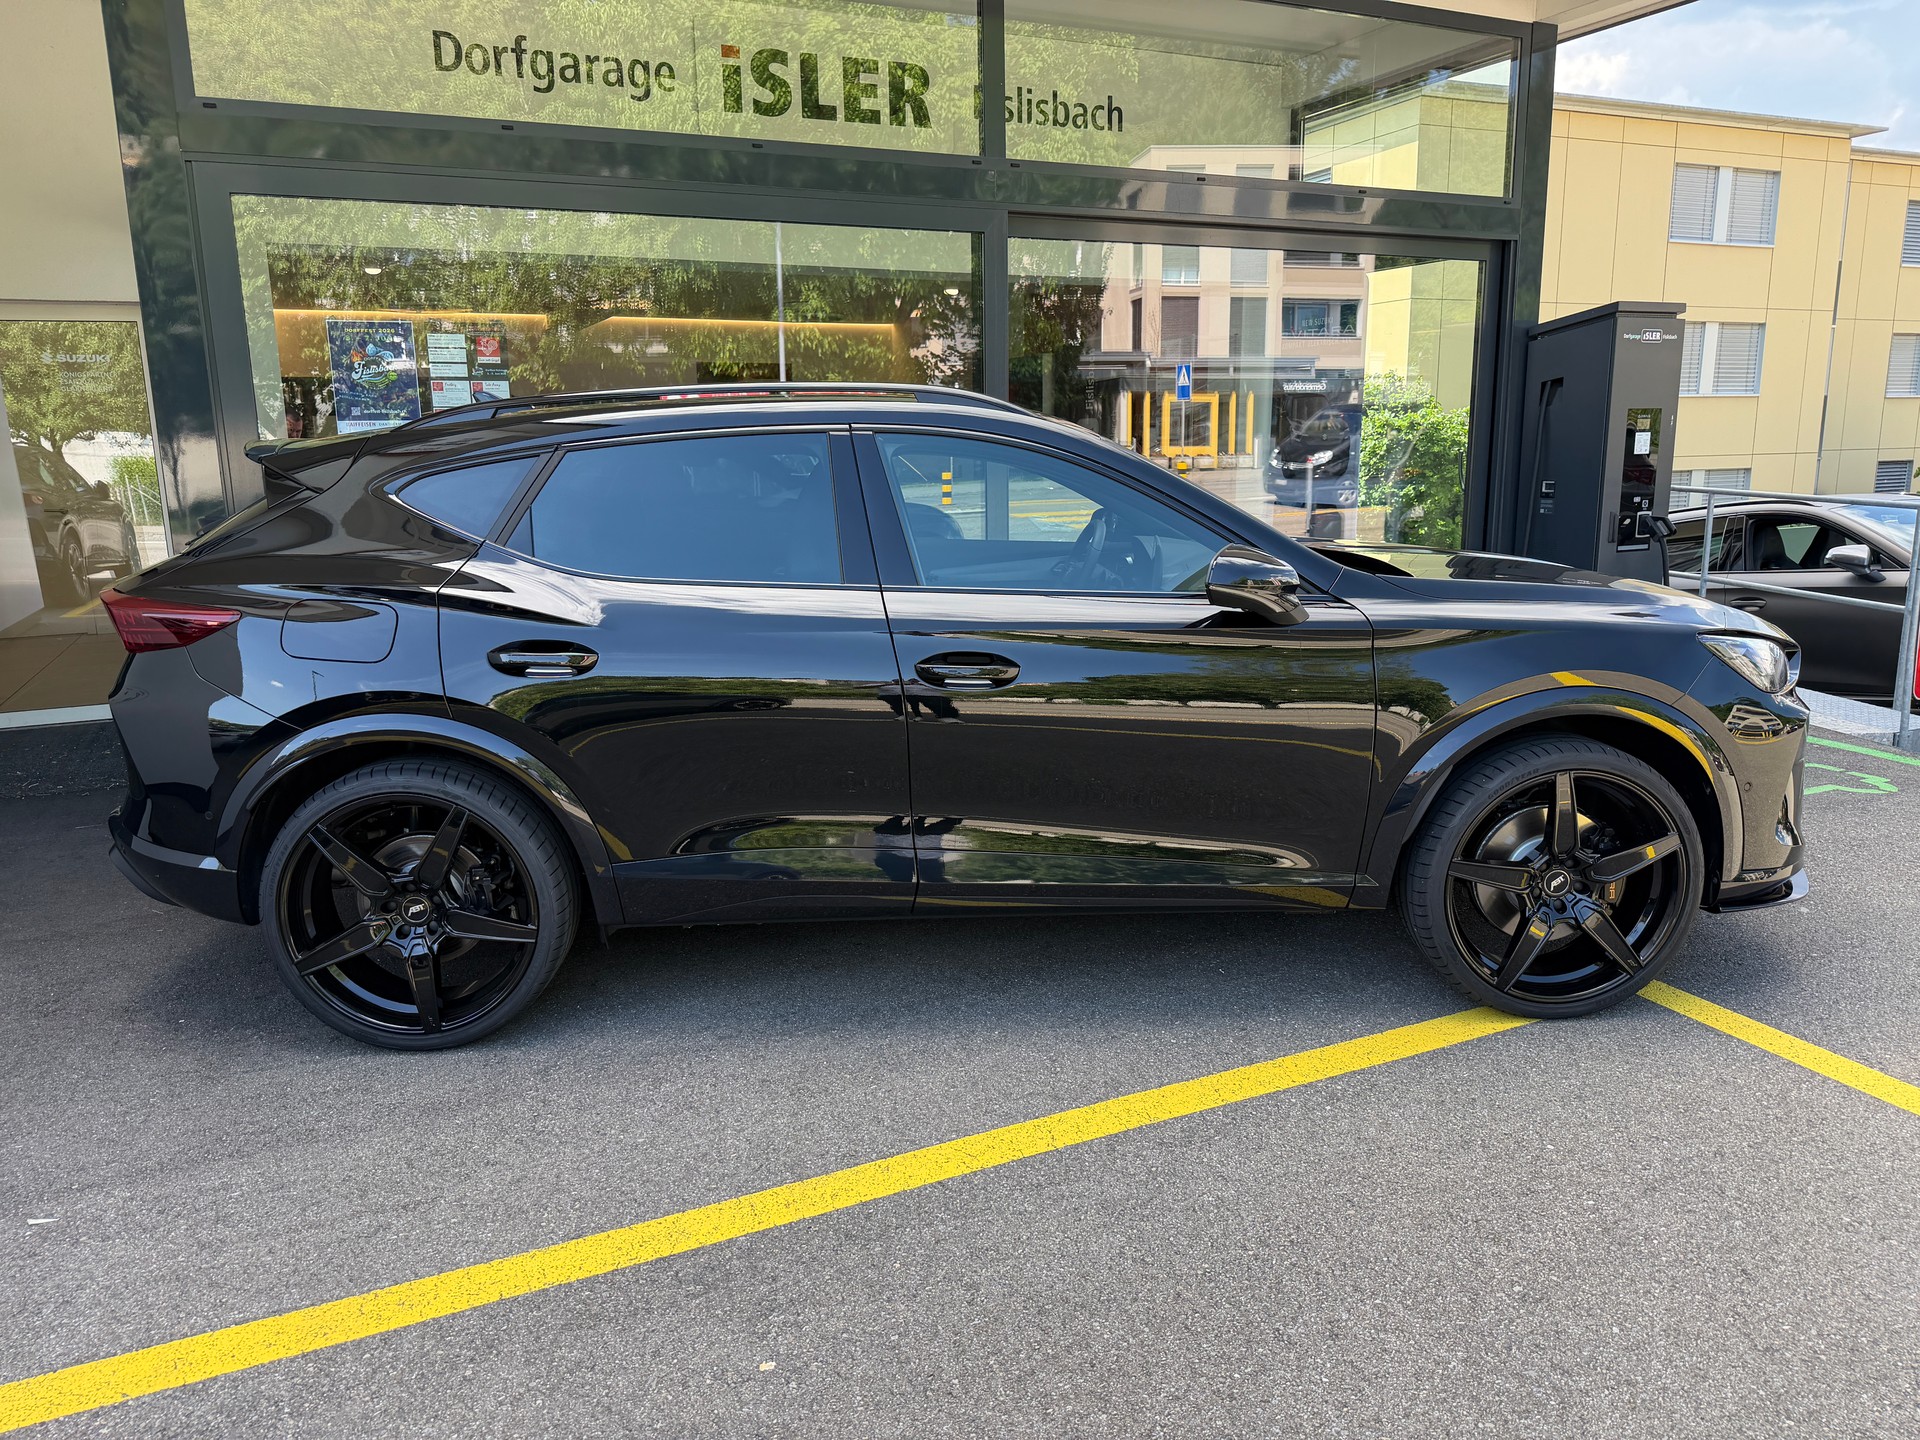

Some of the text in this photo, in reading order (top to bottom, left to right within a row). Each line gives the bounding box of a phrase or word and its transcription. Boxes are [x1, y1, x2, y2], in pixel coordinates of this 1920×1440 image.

[432, 29, 1123, 132] Dorfgarage iSLER slisbach
[57, 354, 110, 363] SUZUKI
